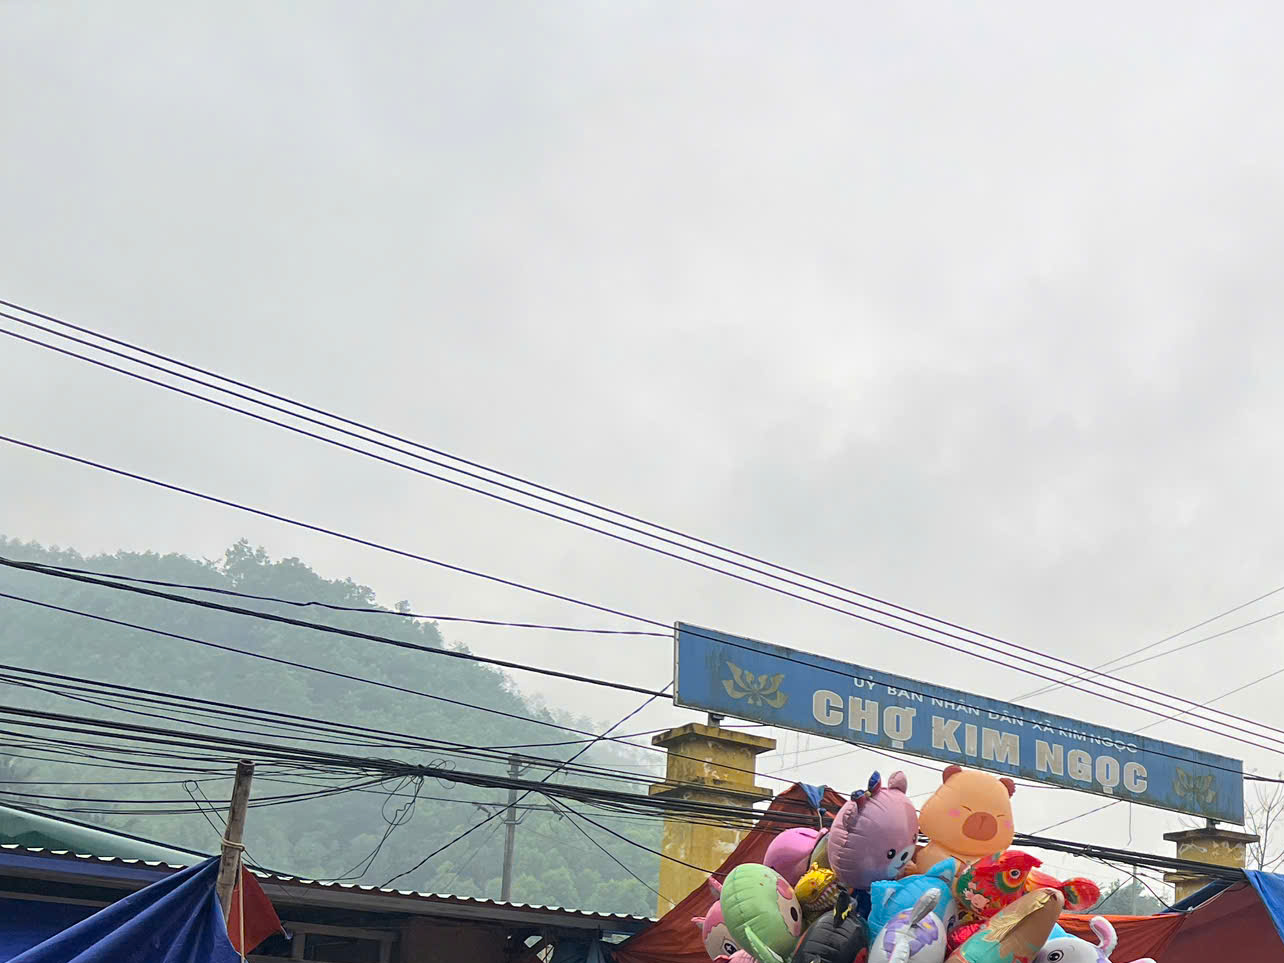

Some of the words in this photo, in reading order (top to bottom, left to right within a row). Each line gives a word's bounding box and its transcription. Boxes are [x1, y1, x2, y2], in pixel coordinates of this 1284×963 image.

[812, 689, 916, 749] CHỢ
[931, 715, 1020, 766] KIM
[1035, 739, 1148, 794] NGỌC
[887, 686, 923, 703] BAN
[932, 698, 980, 716] NHÂN
[1059, 726, 1087, 742] KIM
